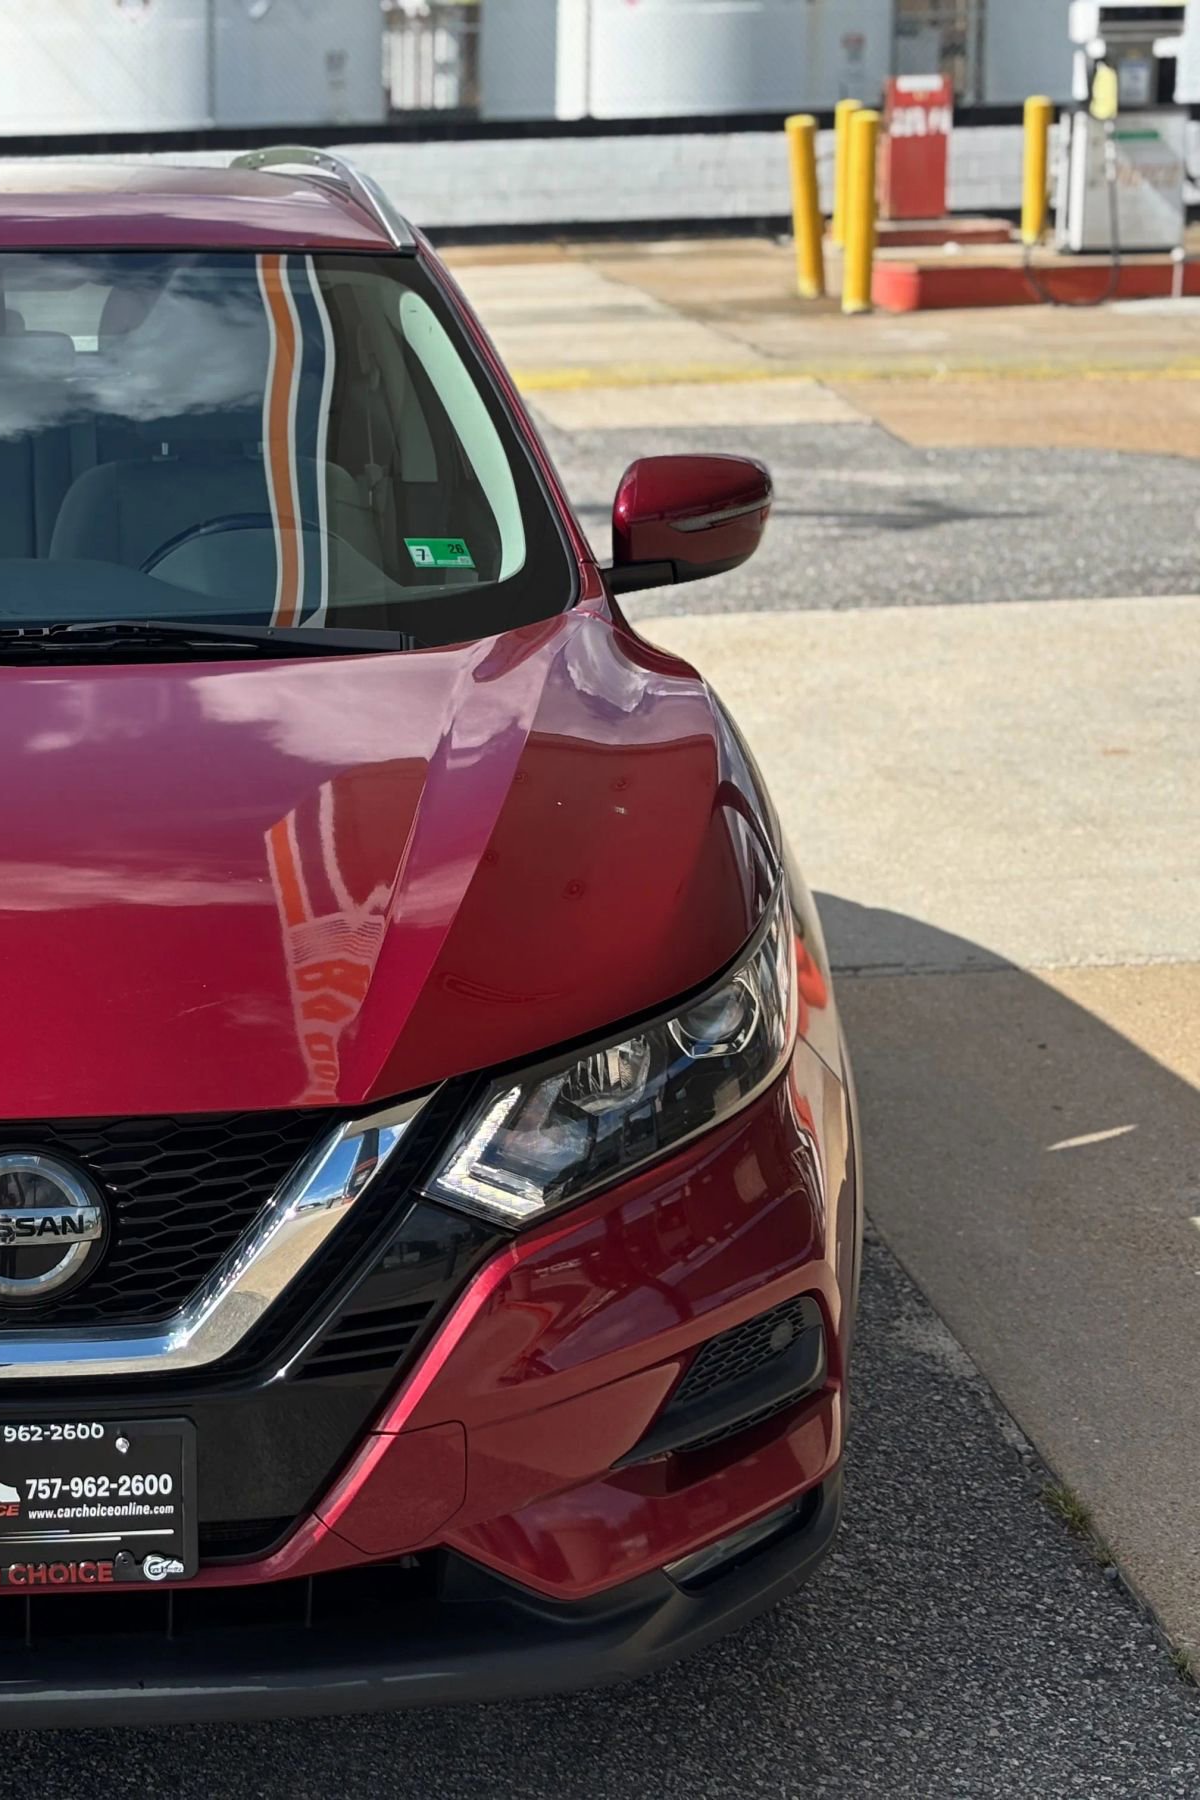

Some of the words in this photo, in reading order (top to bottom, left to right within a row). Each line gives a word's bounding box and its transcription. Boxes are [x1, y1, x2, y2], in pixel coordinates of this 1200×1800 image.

[3, 1422, 105, 1443] 962-2600
[25, 1473, 173, 1500] 757-962-2600
[28, 1501, 175, 1520] www.carchoiceonline.com
[7, 1560, 114, 1586] CHOICE
